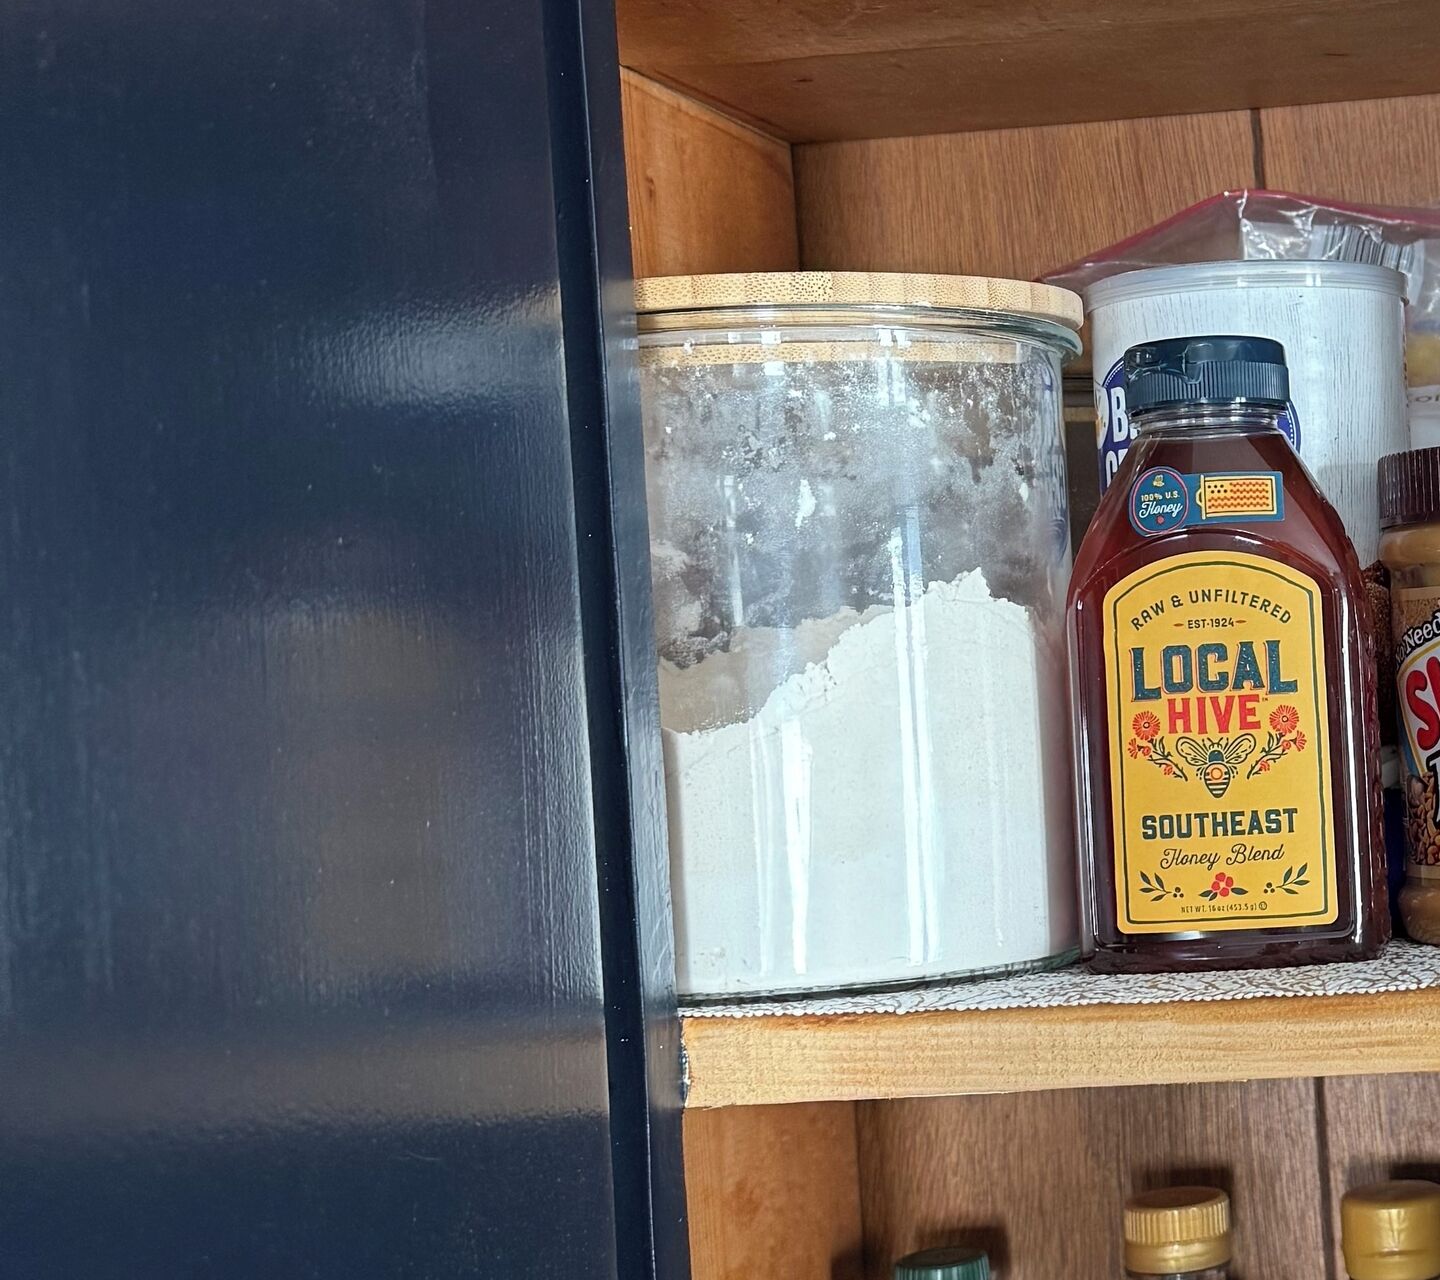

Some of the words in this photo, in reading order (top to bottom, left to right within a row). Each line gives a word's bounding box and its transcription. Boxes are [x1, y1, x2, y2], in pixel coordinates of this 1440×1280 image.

[1139, 501, 1183, 518] Honey
[1140, 493, 1162, 501] 100%
[1165, 491, 1180, 499] U.S.
[1131, 600, 1165, 631] RAW
[1171, 595, 1183, 608] &
[1189, 589, 1291, 624] UNFILTERED
[1129, 640, 1298, 702] LOCAL
[1167, 694, 1261, 734] HIVE
[1142, 808, 1298, 839] SOUTHEAST
[1160, 848, 1221, 871] Honey
[1226, 842, 1285, 866] Blend
